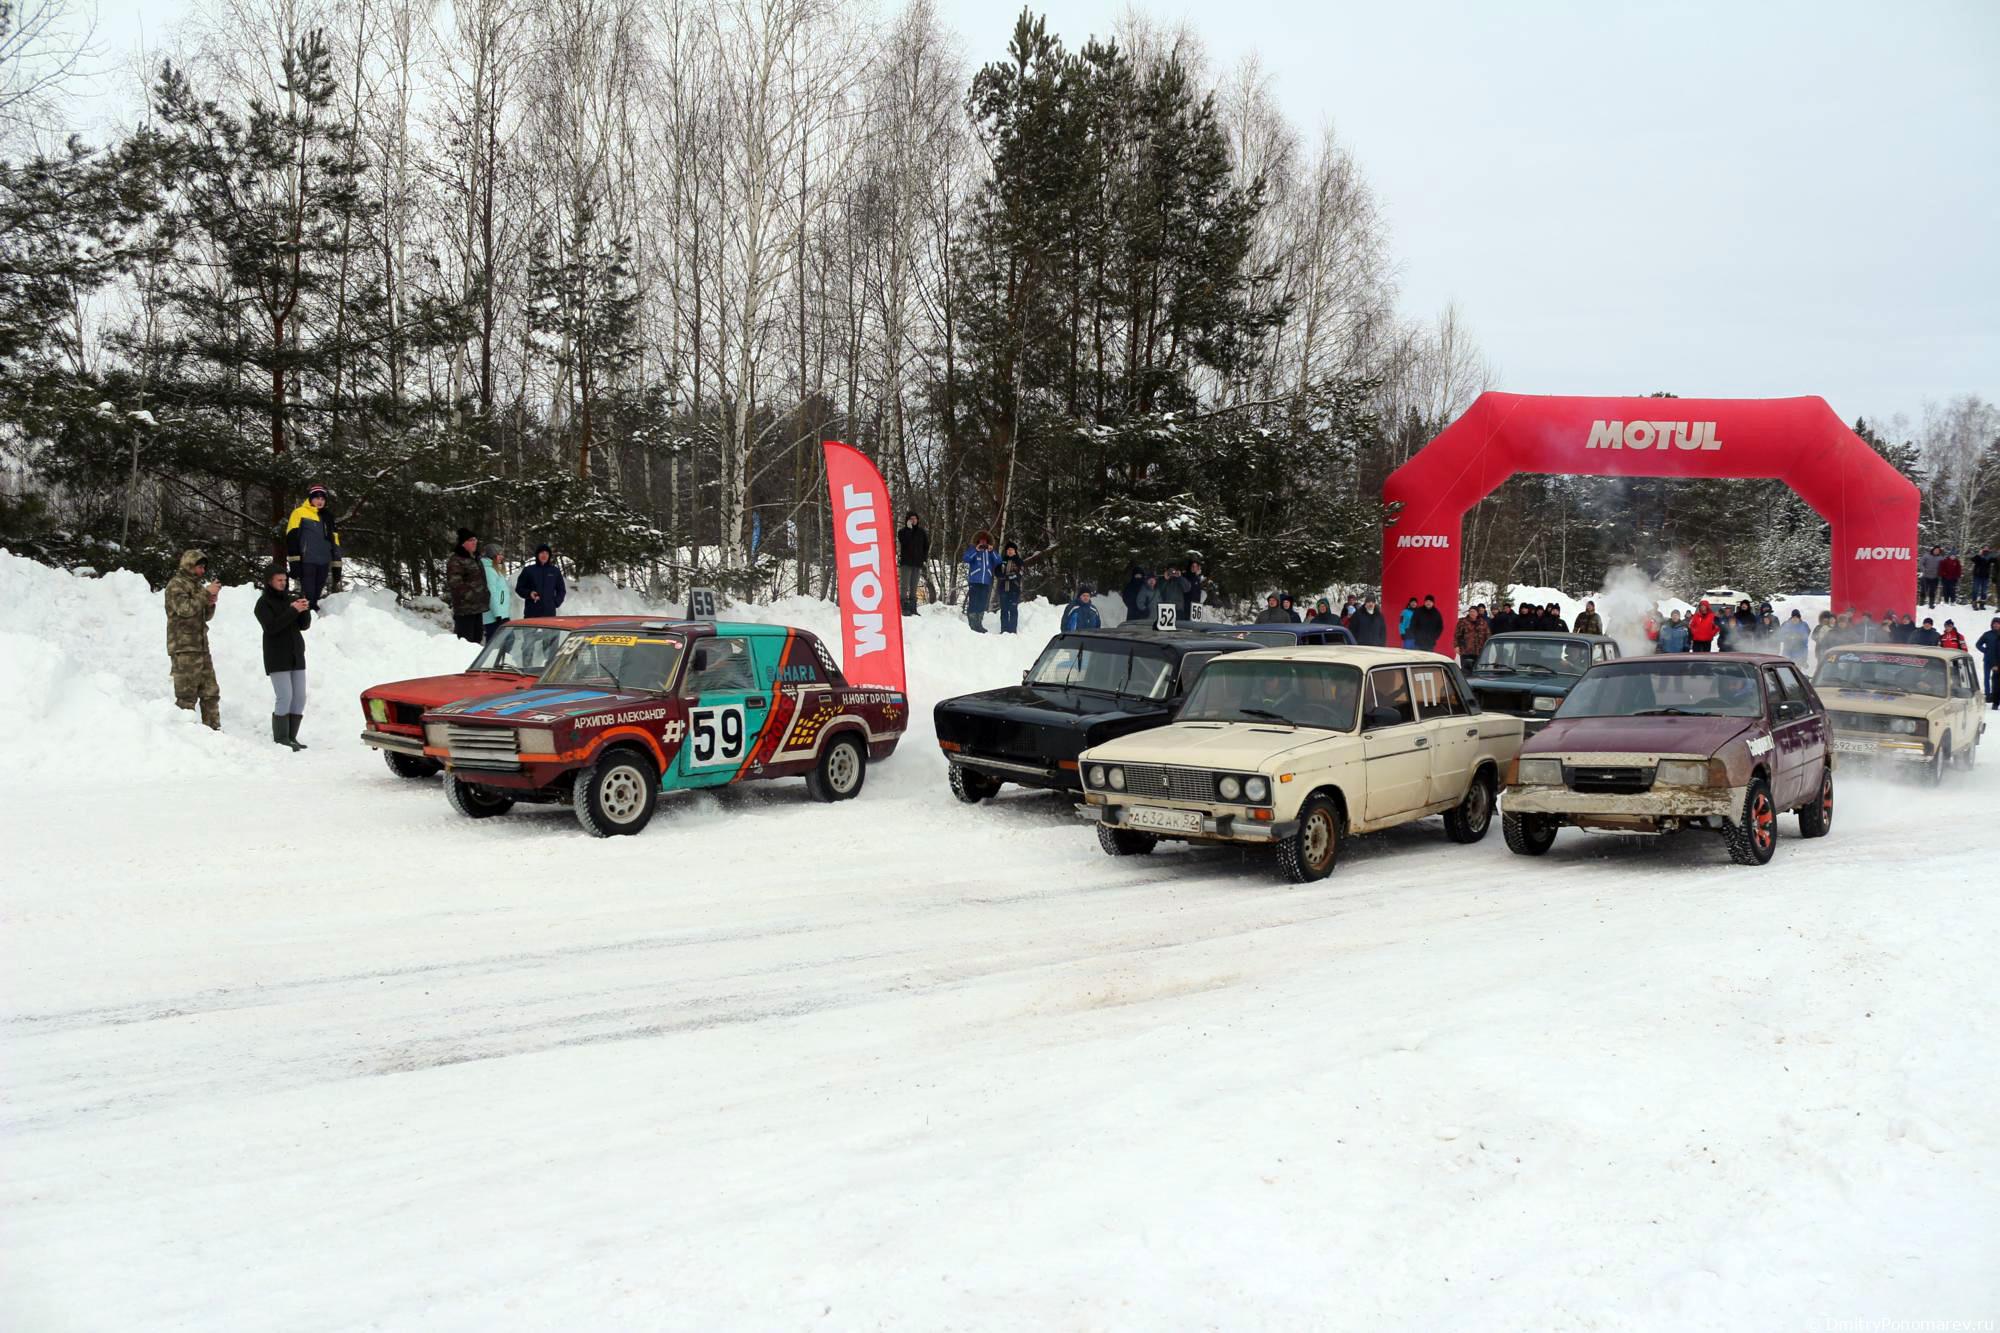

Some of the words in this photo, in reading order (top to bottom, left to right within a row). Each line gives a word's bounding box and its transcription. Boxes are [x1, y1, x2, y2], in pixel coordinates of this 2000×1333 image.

[1585, 420, 1722, 450] MOTUL
[1397, 535, 1449, 548] MOTUL
[1855, 547, 1911, 560] MOTUL
[693, 591, 715, 616] 59
[1192, 605, 1202, 620] 56
[1159, 608, 1175, 627] 52
[574, 714, 615, 730] АРХИПОВ
[617, 708, 667, 724] АЛЕКСАНДР
[692, 708, 743, 762] 59
